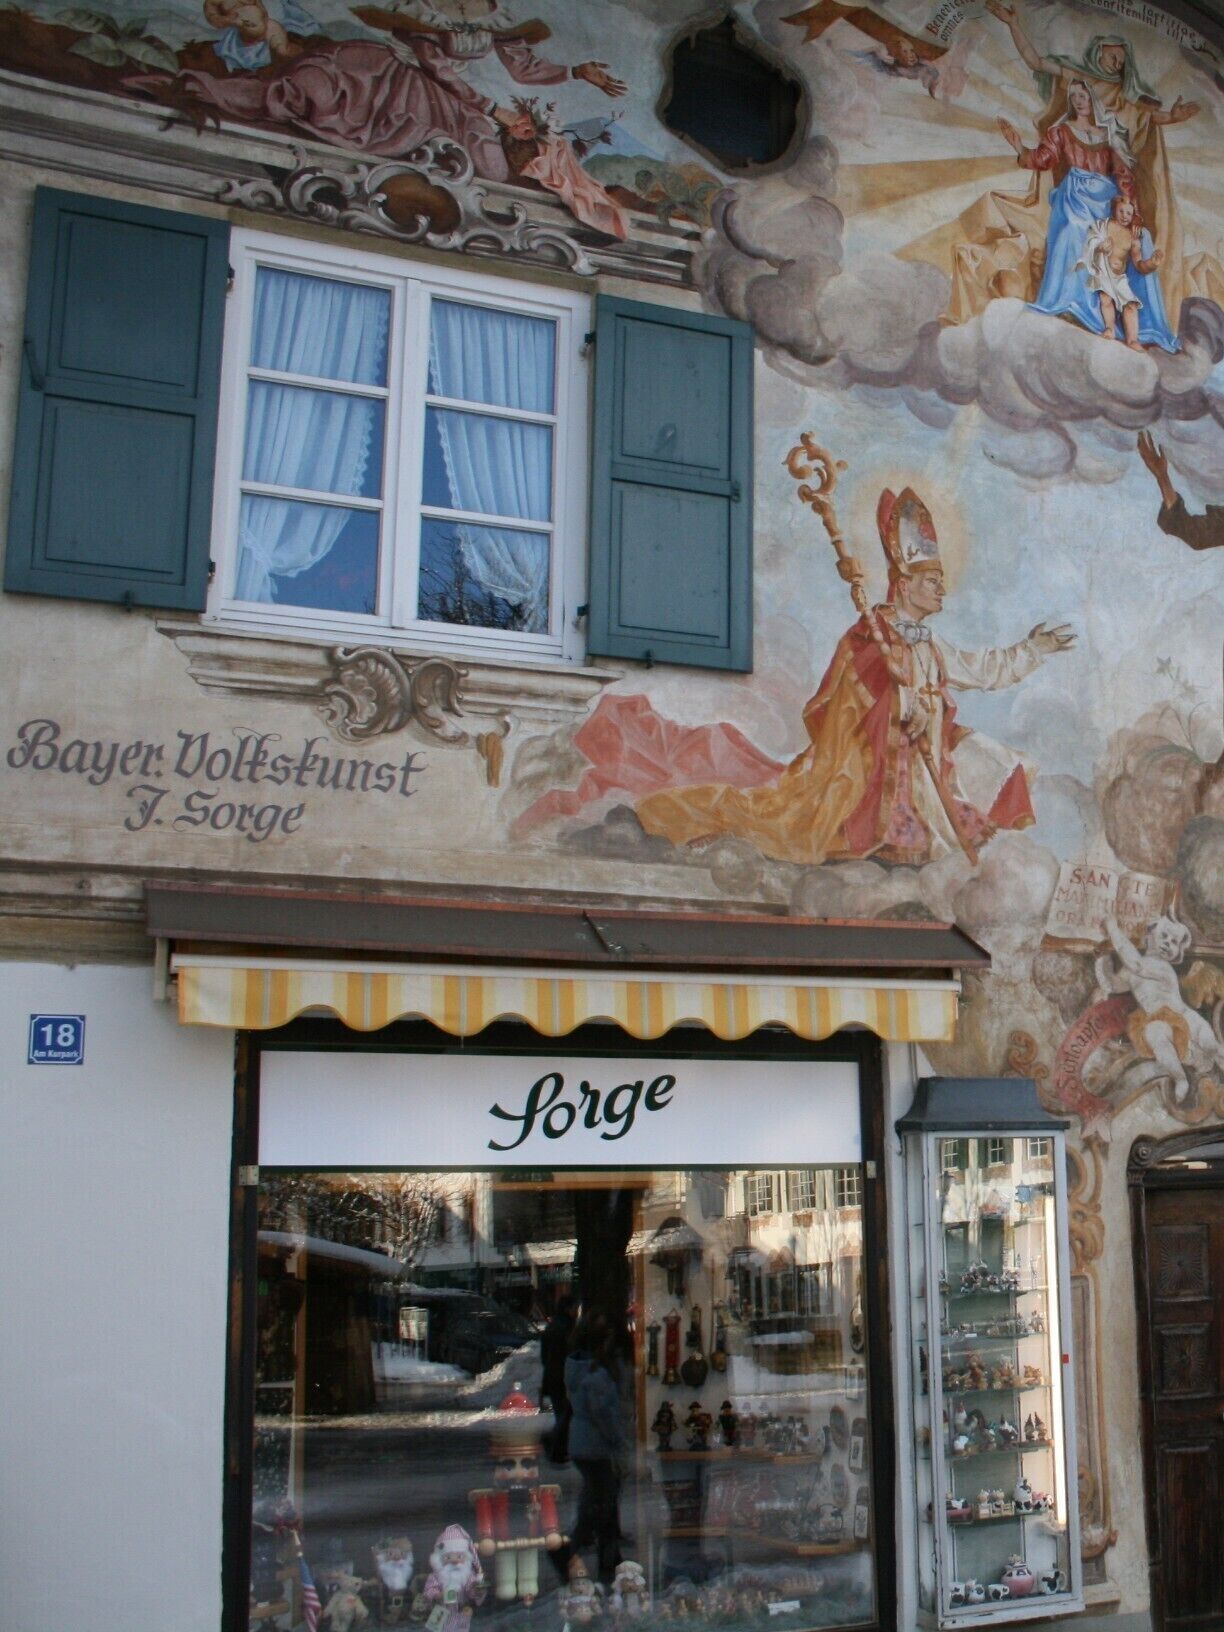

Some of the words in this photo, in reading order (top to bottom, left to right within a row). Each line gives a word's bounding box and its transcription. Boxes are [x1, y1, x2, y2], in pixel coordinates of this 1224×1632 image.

[7, 718, 163, 786] Bayer.
[174, 726, 430, 797] Volkskunst
[172, 786, 305, 843] Sorge
[40, 1023, 75, 1047] 18
[487, 1071, 677, 1151] Sorge
